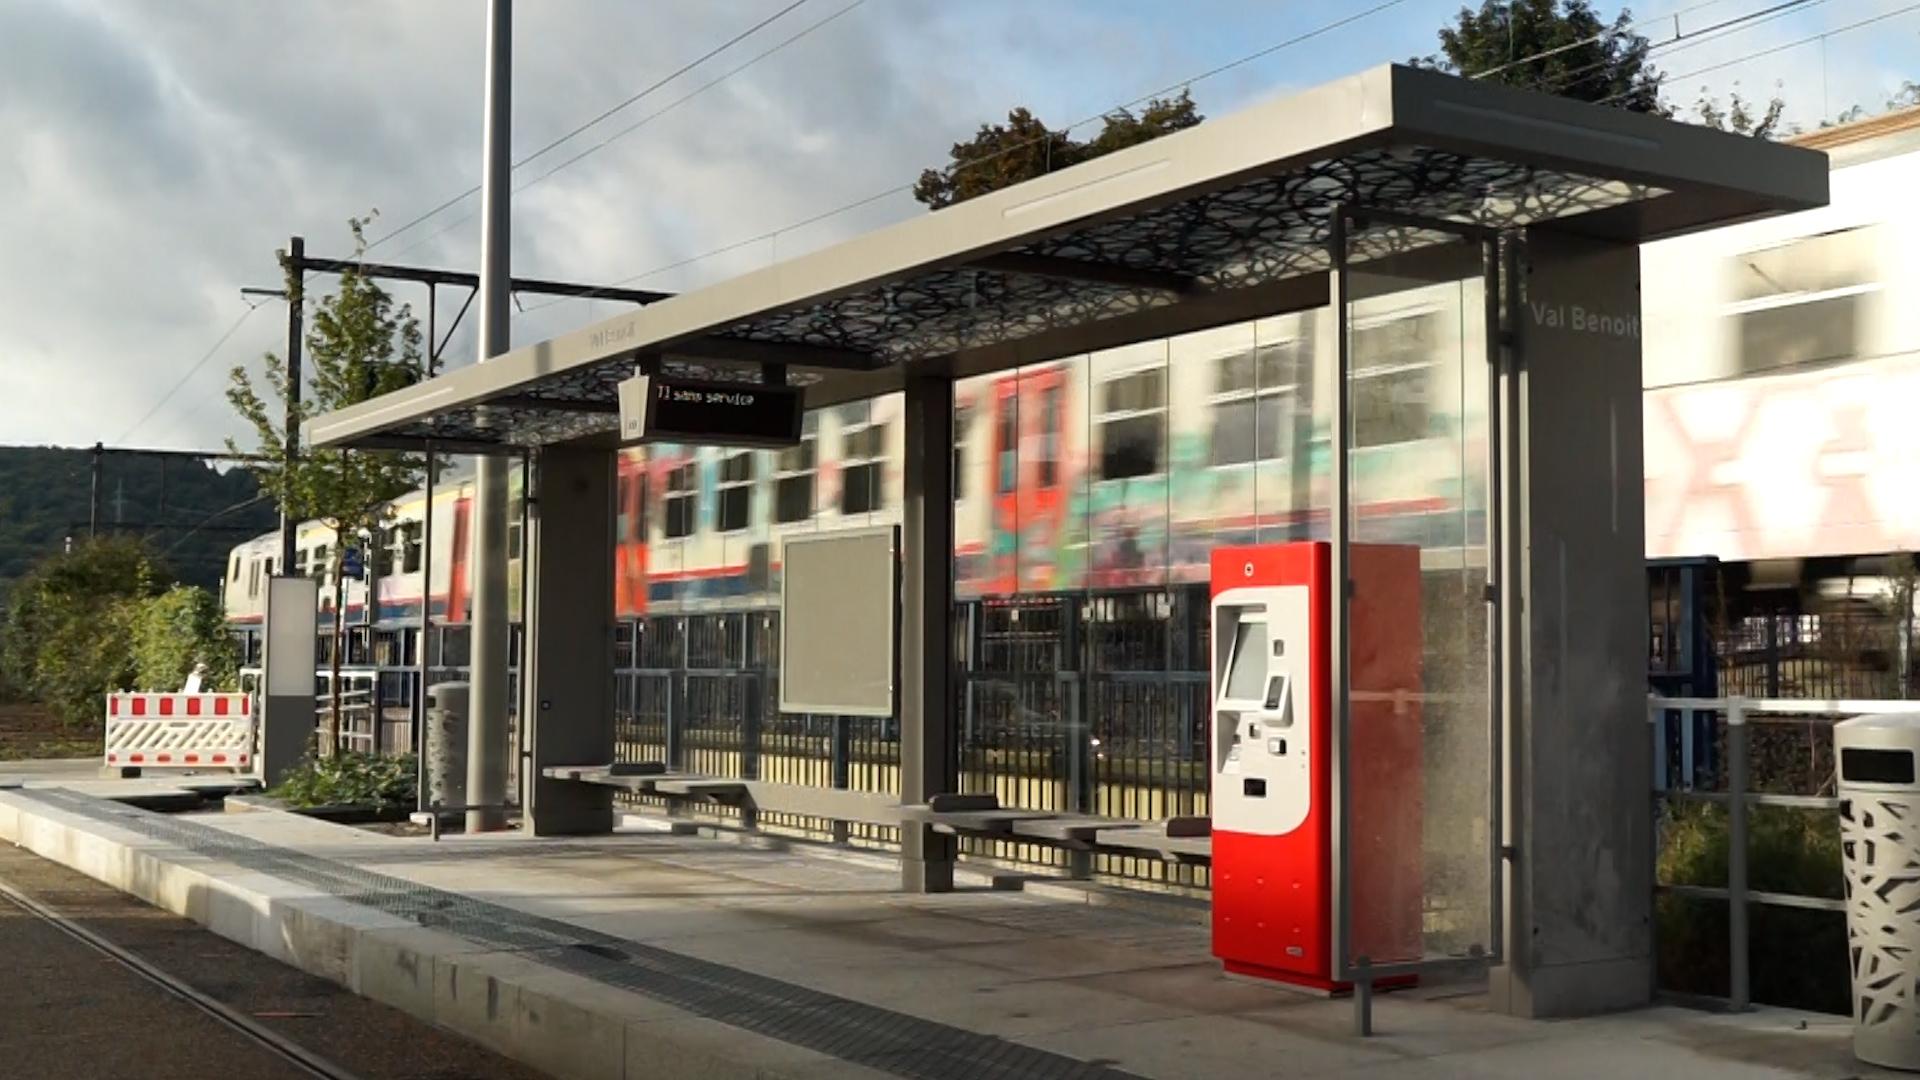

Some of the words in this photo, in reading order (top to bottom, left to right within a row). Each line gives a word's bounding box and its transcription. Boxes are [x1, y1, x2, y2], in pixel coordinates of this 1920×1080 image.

[1531, 302, 1564, 328] Val
[1571, 305, 1639, 338] Benoit
[706, 392, 754, 406] service
